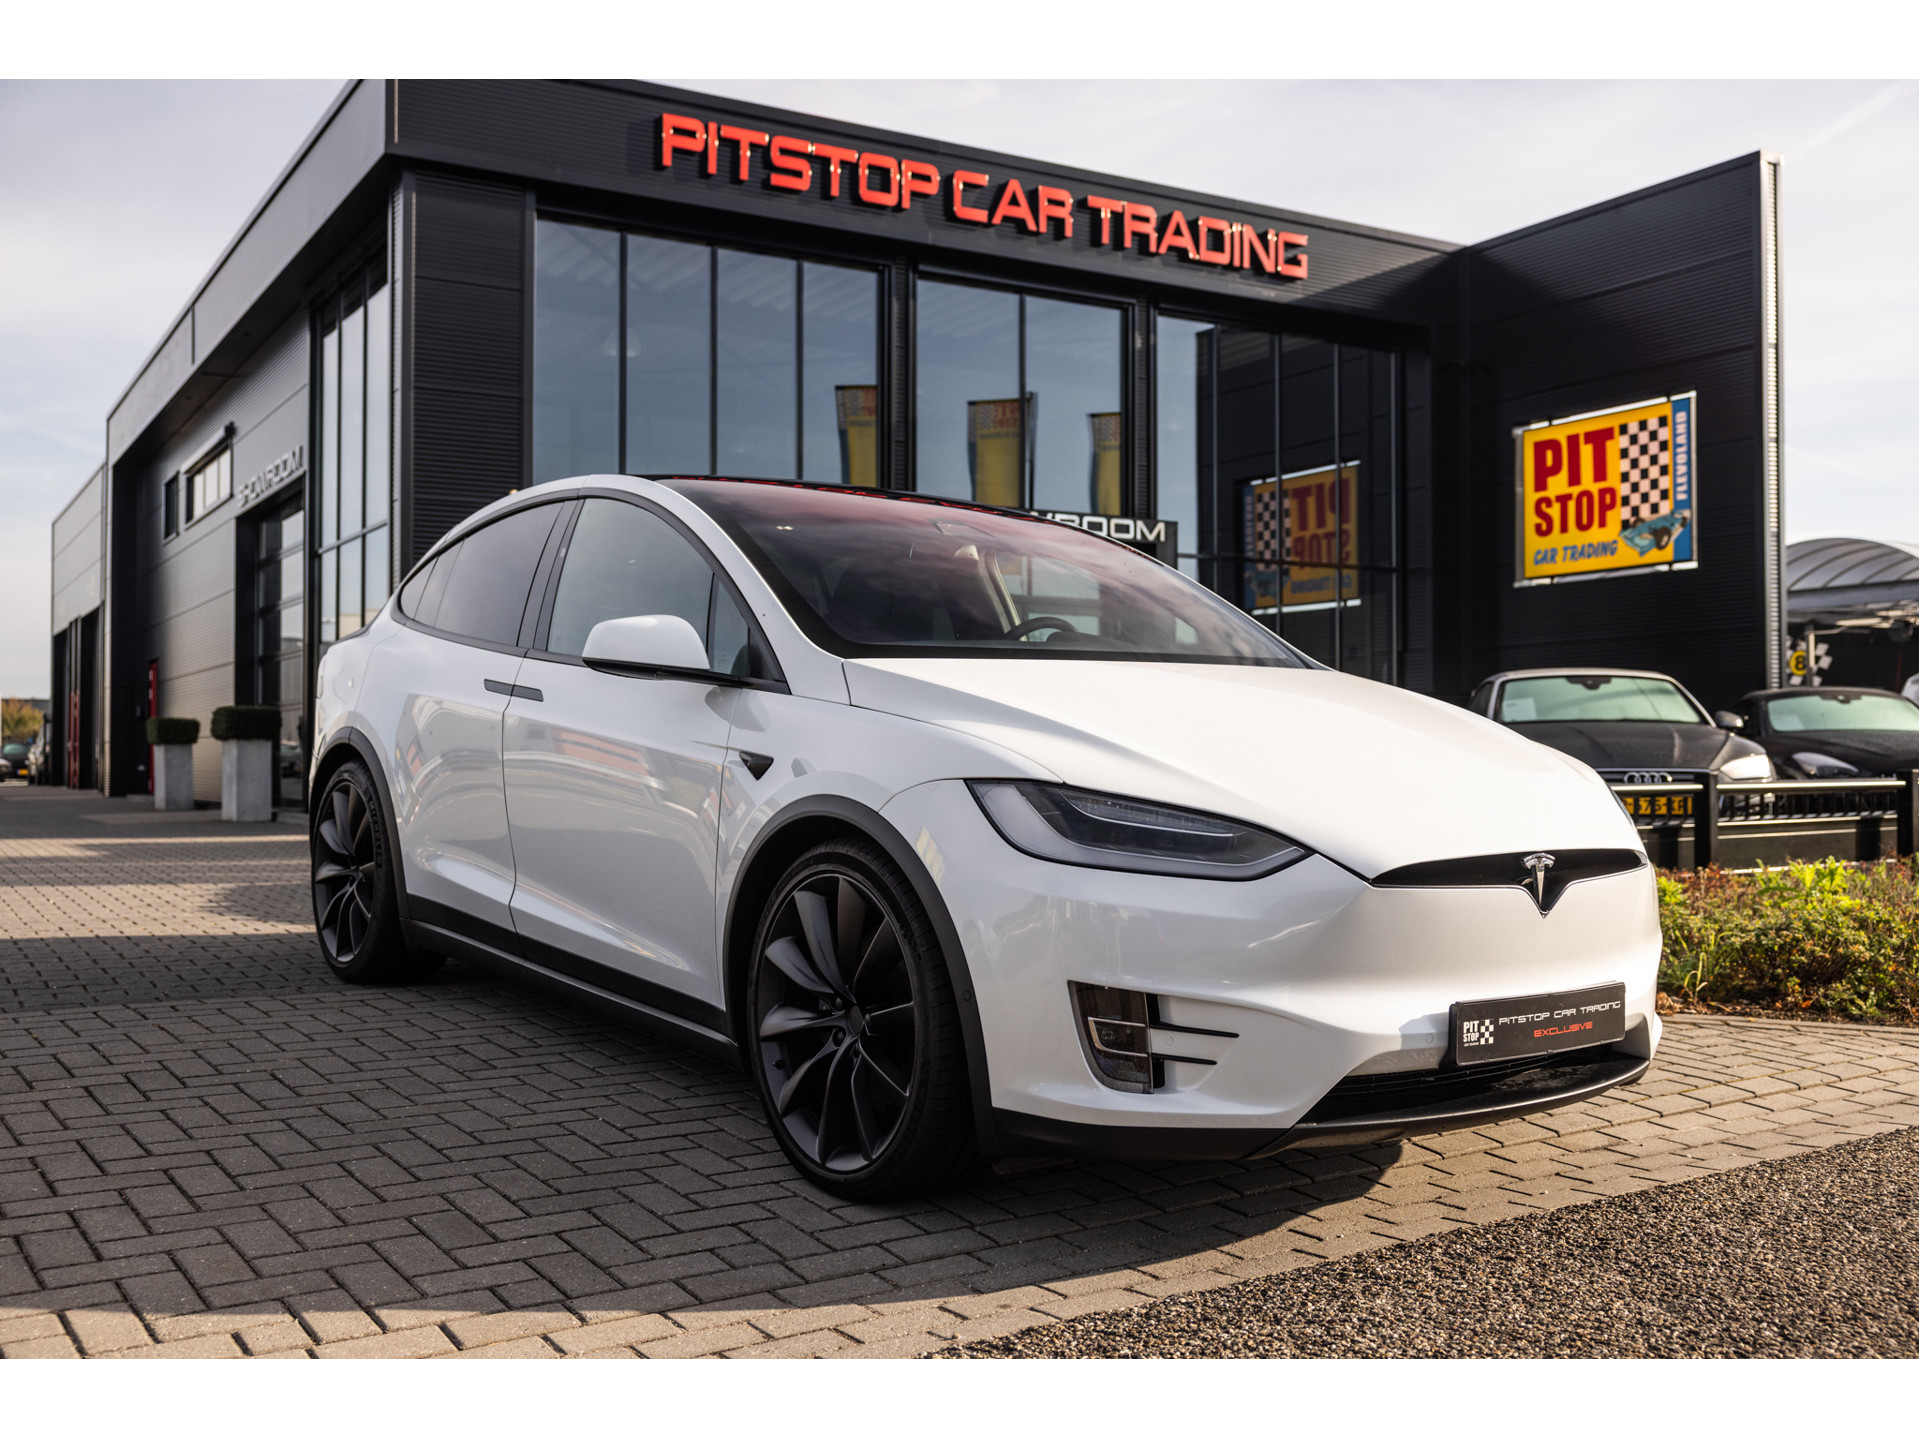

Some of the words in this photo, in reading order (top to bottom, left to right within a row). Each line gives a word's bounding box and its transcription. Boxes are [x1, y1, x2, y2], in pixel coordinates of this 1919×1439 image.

[660, 112, 941, 210] PITSTOP
[952, 168, 1074, 239] CAR
[1086, 194, 1309, 280] TRADING
[1533, 426, 1615, 493] PIT
[1674, 410, 1689, 501] FLEVOLAND
[1534, 486, 1618, 538] STOP
[1533, 547, 1558, 567] CAR
[1561, 539, 1619, 563] TRADING
[1463, 1020, 1480, 1034] PIT
[1498, 1011, 1551, 1026] PITSTOP
[1553, 1007, 1577, 1019] CAR
[1579, 1000, 1621, 1014] TRADING
[1463, 1032, 1480, 1042] STOP
[1533, 1021, 1594, 1038] EXCLUSIVE
